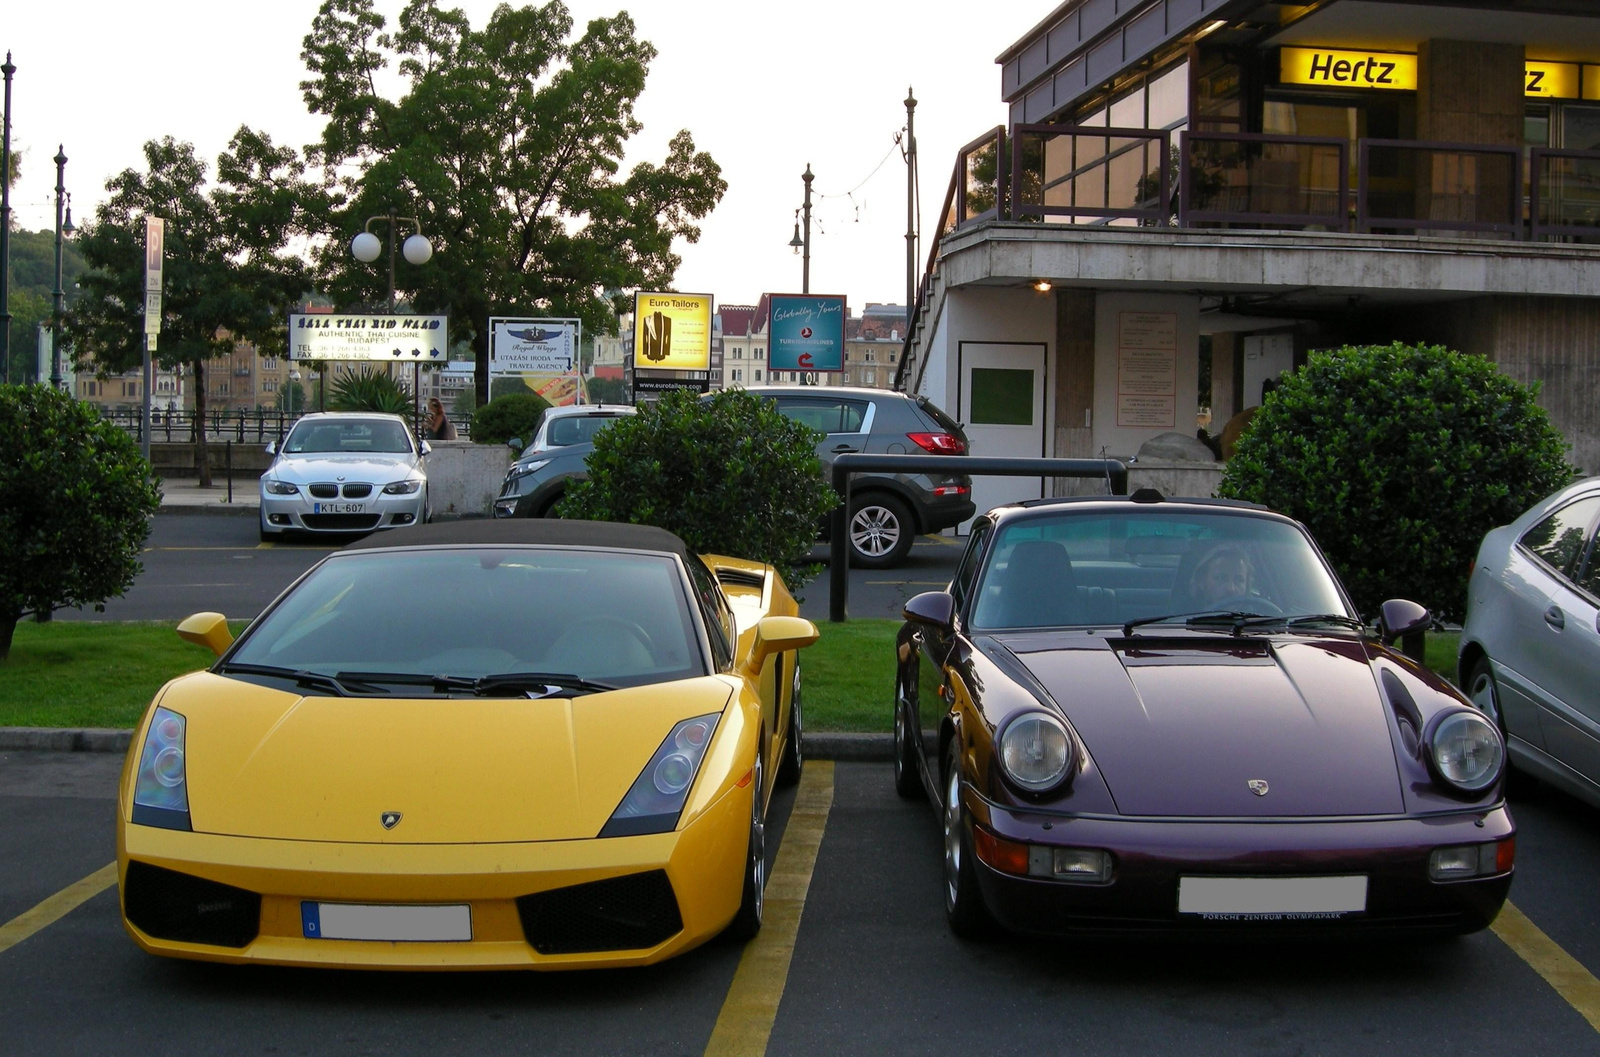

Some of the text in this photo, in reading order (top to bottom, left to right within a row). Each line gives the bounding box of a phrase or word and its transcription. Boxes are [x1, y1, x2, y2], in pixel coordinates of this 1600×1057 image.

[1309, 53, 1396, 84] Hertz
[151, 231, 159, 265] P
[649, 299, 700, 308] Euro Tailors
[773, 301, 841, 323] Globally Yours
[336, 318, 366, 329] THAI
[512, 344, 556, 353] Royal Wings
[321, 504, 363, 512] KTL-607
[308, 922, 315, 931] D
